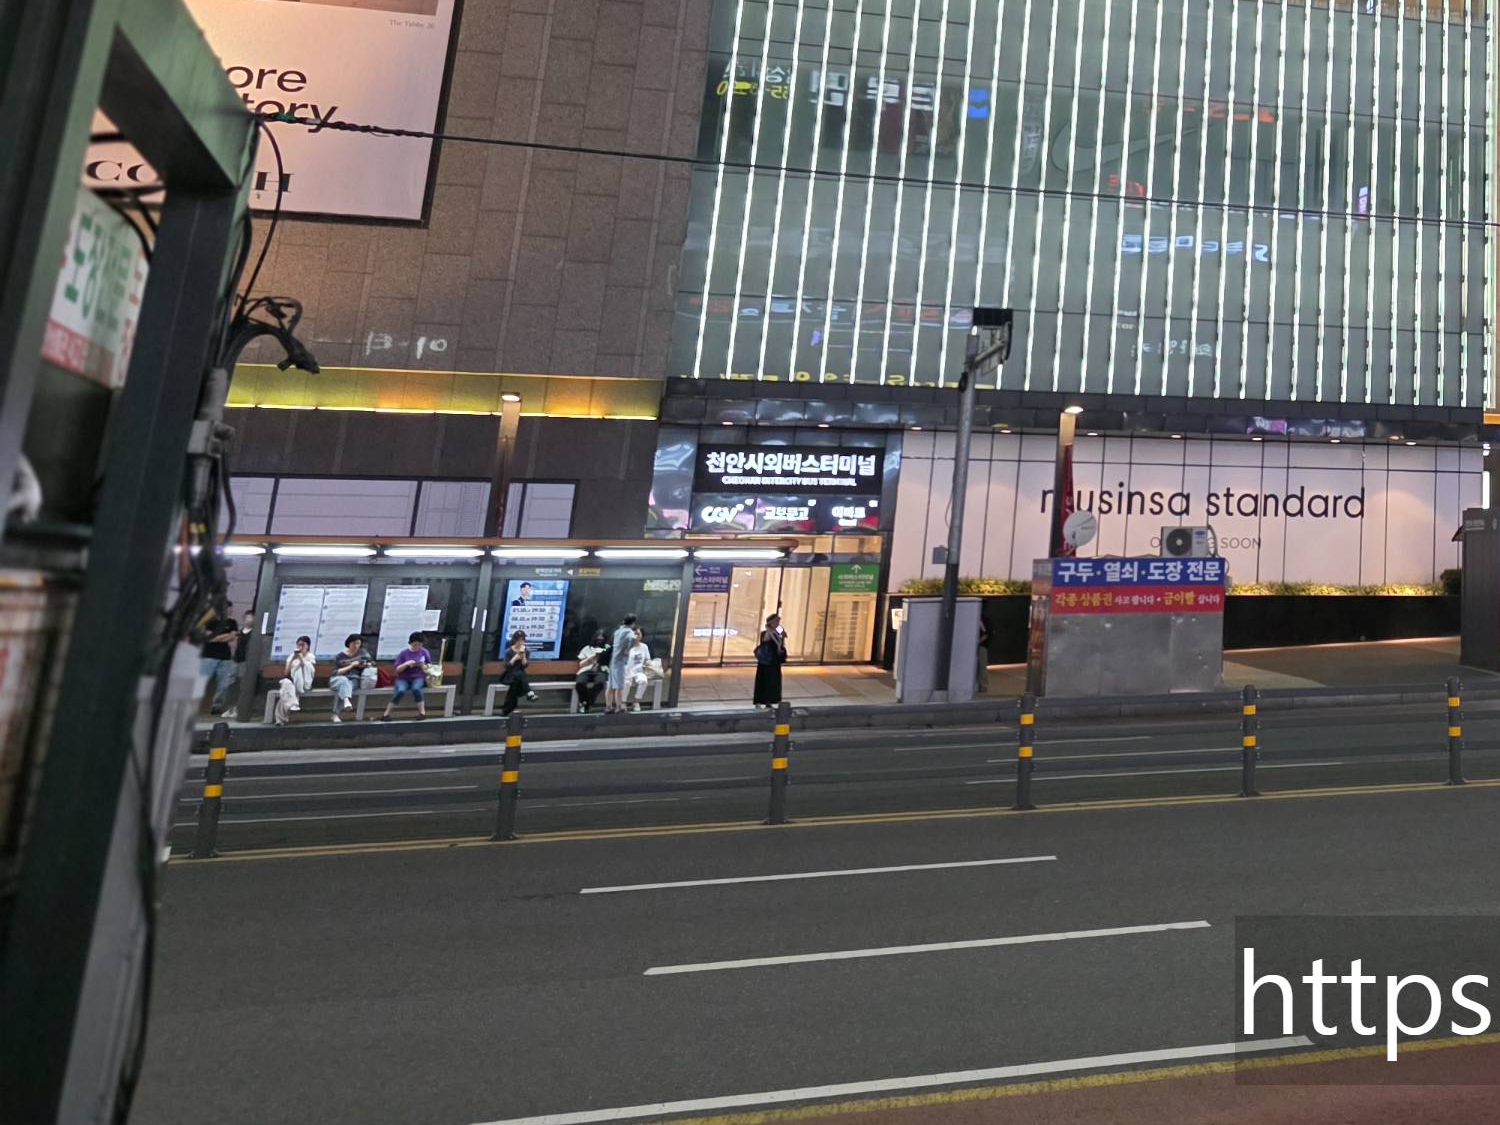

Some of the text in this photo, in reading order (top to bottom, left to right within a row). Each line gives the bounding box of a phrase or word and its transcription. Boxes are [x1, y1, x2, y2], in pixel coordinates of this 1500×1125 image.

[226, 65, 307, 93] ore
[242, 93, 338, 134] tory
[705, 451, 877, 477] 천안시외버스터미널
[1206, 485, 1365, 519] standard
[701, 505, 737, 524] CGV
[763, 505, 811, 522] 교보문고
[1220, 536, 1262, 550] SOON
[1058, 561, 1094, 583] 구두
[1103, 561, 1138, 582] 열쇠
[1147, 561, 1183, 582] 도장
[1186, 561, 1221, 581] 전문
[1055, 592, 1077, 607] 각종
[1079, 592, 1113, 607] 상품권
[1114, 596, 1130, 605] 사고
[1163, 591, 1195, 606] 금이빨
